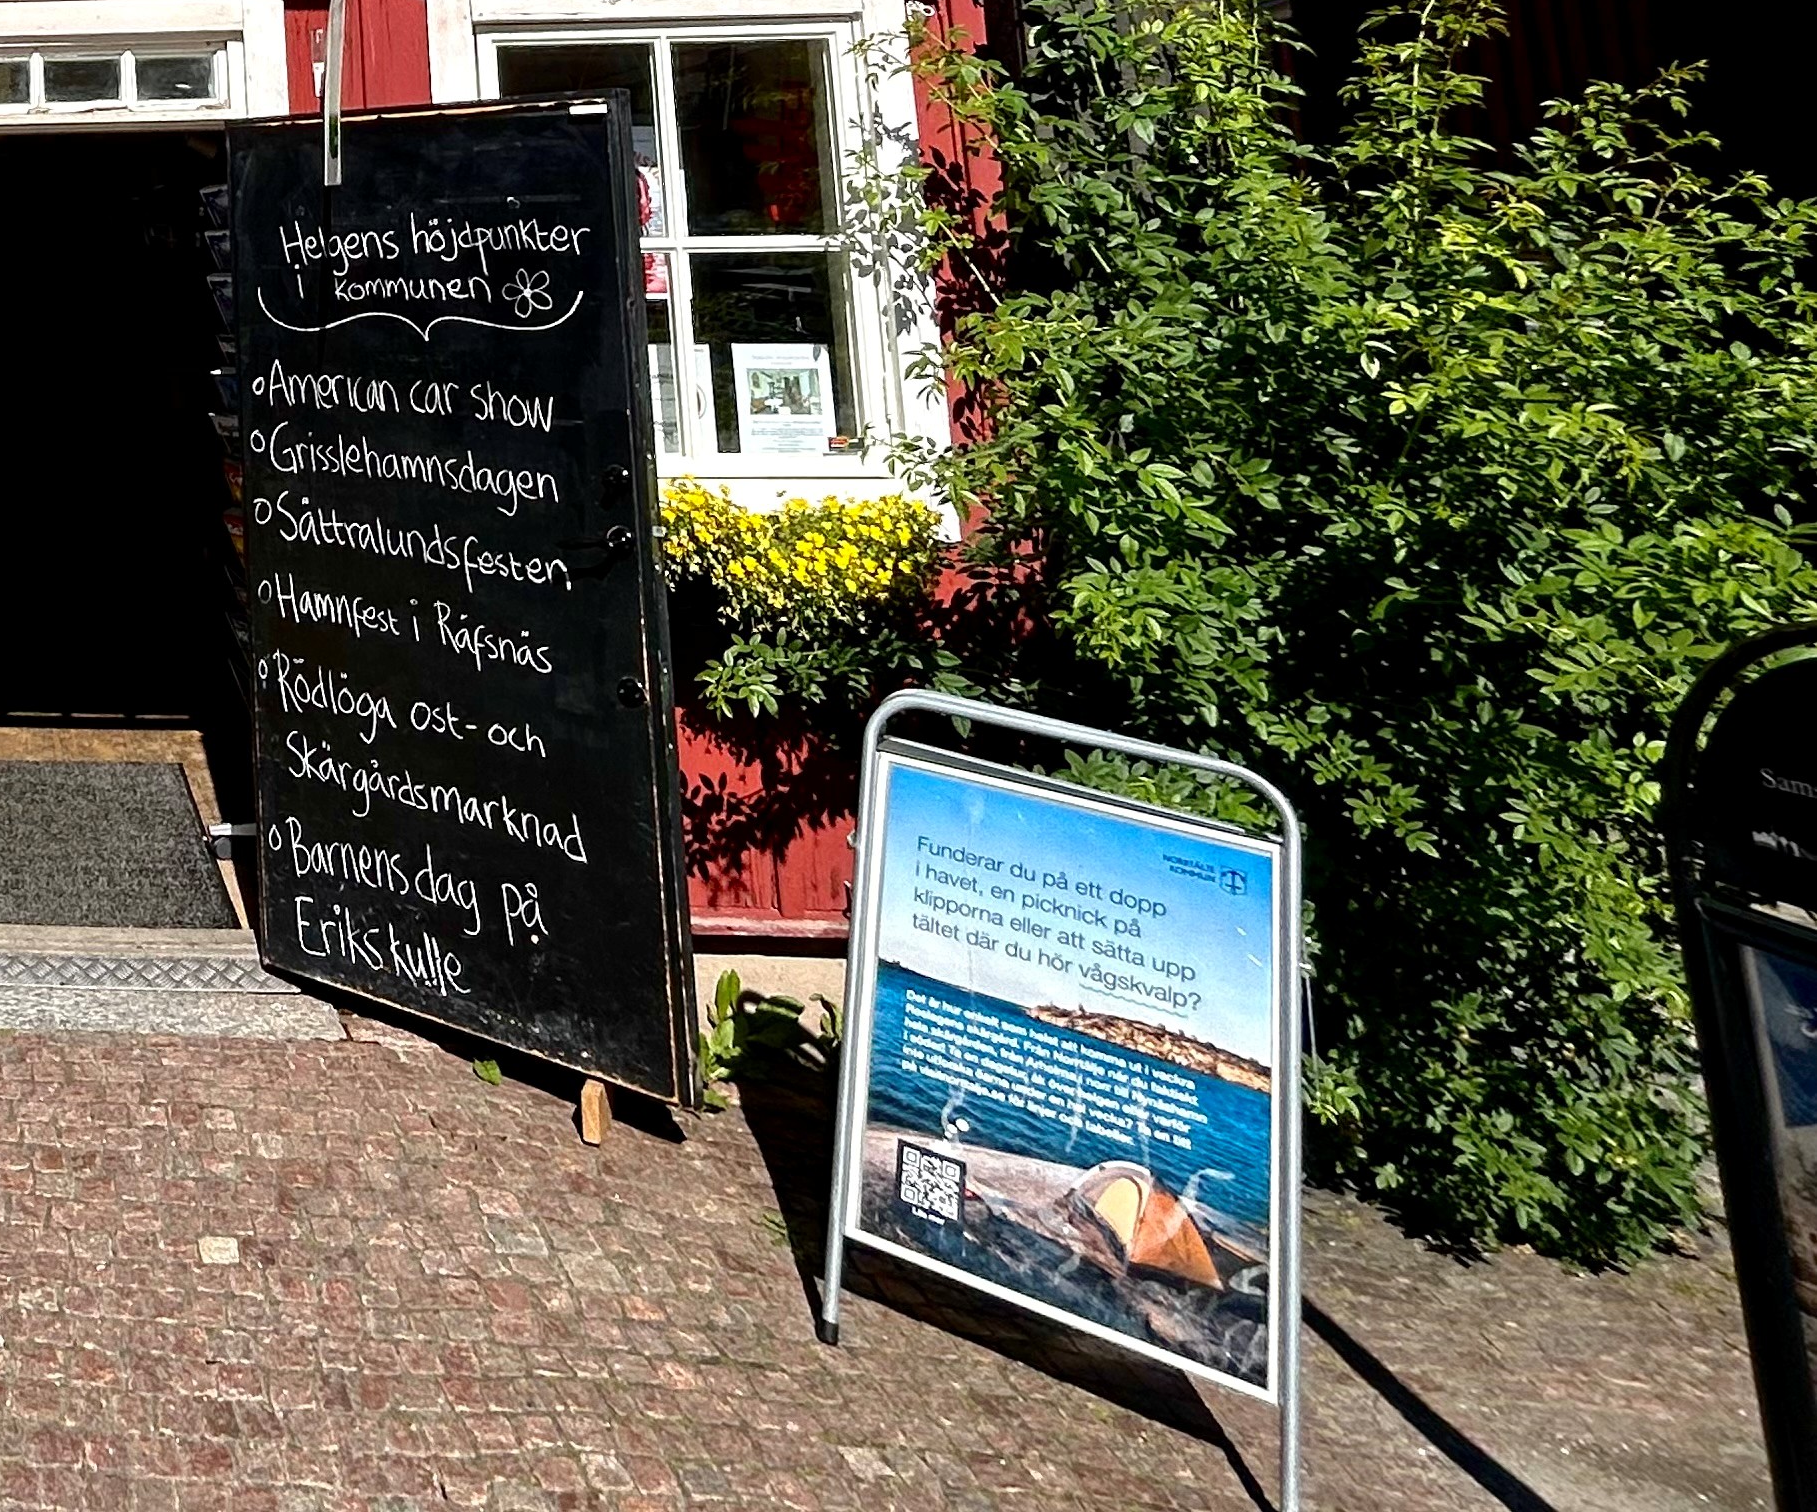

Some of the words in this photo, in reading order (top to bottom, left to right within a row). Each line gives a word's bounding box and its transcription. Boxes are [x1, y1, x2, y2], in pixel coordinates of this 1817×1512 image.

[279, 220, 399, 276] Helgens
[410, 212, 590, 275] höjdpunkter
[293, 263, 304, 299] i
[334, 273, 492, 304] kommunen
[269, 358, 399, 413] American
[409, 379, 459, 416] car
[470, 381, 554, 433] show
[269, 421, 559, 517] Grisslehamnsdagen
[276, 573, 399, 639] Hamnfest
[410, 599, 421, 641] i
[272, 649, 397, 744] Rödlöga
[488, 722, 546, 757] och
[287, 730, 588, 864] Skärgårdsmarknad
[501, 883, 549, 946] på
[915, 860, 920, 876] i
[926, 863, 983, 896] havet,
[991, 885, 1015, 903] en
[1022, 893, 1108, 929] picknick
[1114, 918, 1141, 938] på
[917, 835, 1004, 872] Funderar
[1010, 862, 1036, 882] du
[1043, 871, 1068, 891] på
[1075, 881, 1103, 900] ett
[1109, 888, 1167, 919] dopp
[912, 913, 960, 941] tältet
[966, 930, 999, 951] där
[1005, 941, 1031, 962] du
[1038, 948, 1073, 974] hör
[1078, 963, 1202, 1011] vågskvalp?
[914, 886, 1004, 926] klipporna
[1010, 916, 1051, 939] eller
[1057, 930, 1085, 950] att
[1091, 939, 1145, 967] sätta
[1152, 956, 1196, 983] upp
